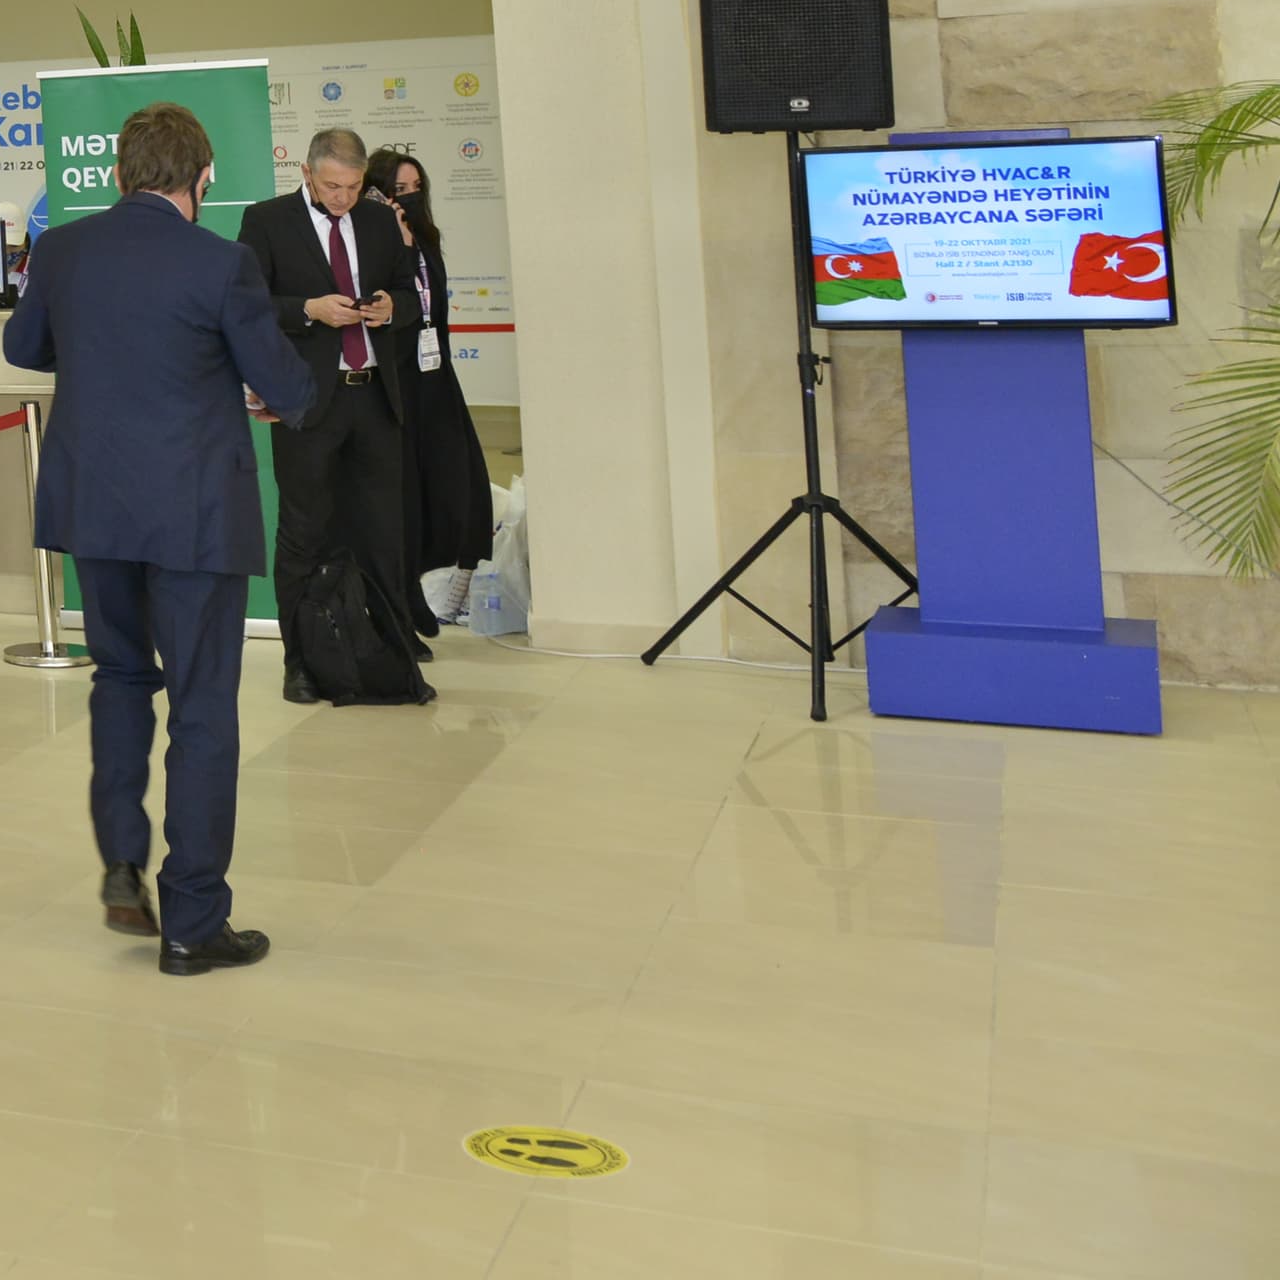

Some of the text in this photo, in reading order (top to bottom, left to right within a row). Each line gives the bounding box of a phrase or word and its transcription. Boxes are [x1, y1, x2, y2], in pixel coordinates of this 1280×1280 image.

[61, 133, 118, 157] MƏT
[1, 161, 15, 171] 21
[20, 160, 33, 170] 22
[36, 160, 45, 171] O
[62, 166, 113, 193] QEY
[885, 166, 1071, 185] TÜRKİYƏ HVAC&R
[852, 182, 1110, 206] NÜMAYƏNDƏ HEYƏTİNİN
[862, 203, 1104, 226] AZƏRBAYCANA SƏFƏRİ
[934, 239, 959, 247] 19-22
[960, 238, 1007, 246] OKTYABR
[973, 260, 1000, 268] Stant
[453, 347, 479, 359] .az
